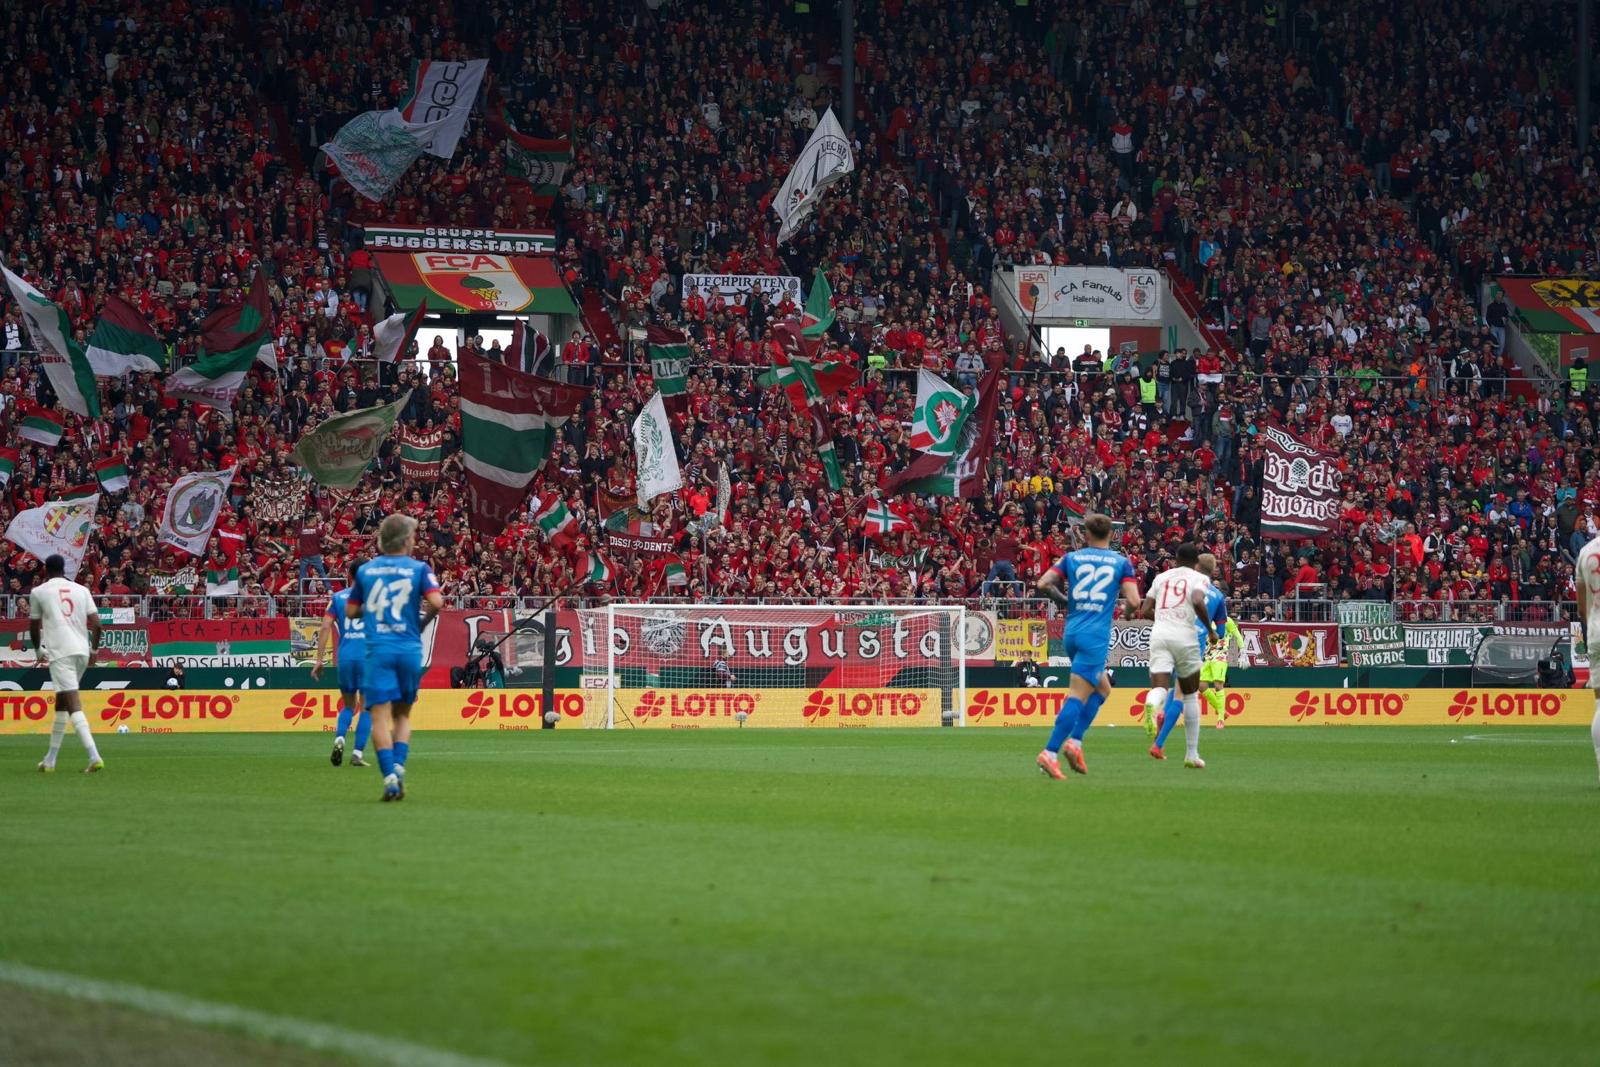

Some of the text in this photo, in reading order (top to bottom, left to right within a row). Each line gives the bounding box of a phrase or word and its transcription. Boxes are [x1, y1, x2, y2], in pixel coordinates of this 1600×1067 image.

[374, 235, 545, 253] FUGGERSTADT
[425, 227, 496, 239] GRUPPE
[425, 255, 504, 270] FCA
[1022, 272, 1046, 282] FCA
[1130, 275, 1154, 286] FCA
[1054, 279, 1123, 302] FCA Fanclub
[402, 424, 442, 448] Legio
[1072, 563, 1115, 601] 22
[58, 589, 75, 617] 5
[366, 578, 413, 621] 47
[1160, 579, 1188, 609] 19
[168, 621, 206, 637] FCA
[230, 620, 276, 636] FANS
[698, 614, 941, 666] Augusta
[1352, 626, 1398, 644] BLOCK
[1405, 630, 1473, 648] AUGSBURG
[1351, 650, 1406, 667] BRIGADE
[1428, 648, 1450, 663] OST
[141, 695, 233, 719] LOTTO
[671, 693, 755, 717] LOTTO
[839, 693, 921, 716] LOTTO
[1003, 693, 1067, 716] LOTT
[1324, 693, 1404, 716] LOTTO
[1482, 693, 1561, 716] LOTTO
